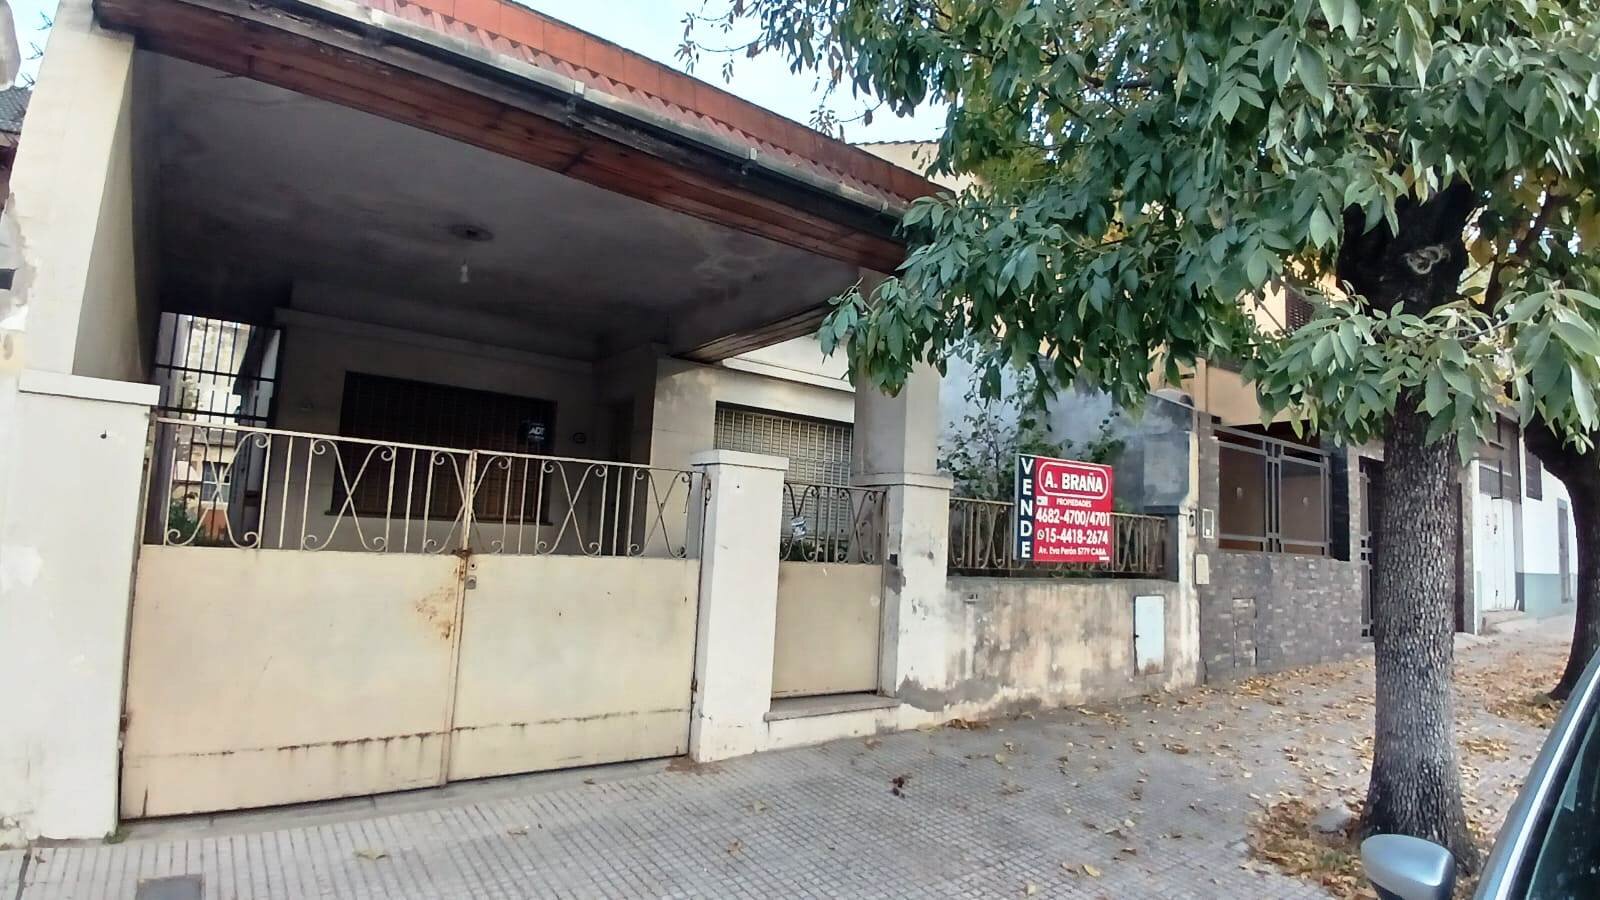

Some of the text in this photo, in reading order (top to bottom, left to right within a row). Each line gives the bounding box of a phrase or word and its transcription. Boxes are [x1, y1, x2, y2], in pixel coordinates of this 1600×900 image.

[1044, 471, 1104, 493] A. BRAÑA
[1020, 457, 1034, 558] VENDE
[1056, 498, 1092, 508] PROPIEDADES
[1036, 507, 1110, 527] 4682-4700/4701
[1045, 527, 1108, 545] 15-4418-2674
[1038, 546, 1048, 554] Av.
[1049, 546, 1060, 555] Eva
[1061, 546, 1077, 556] Perón
